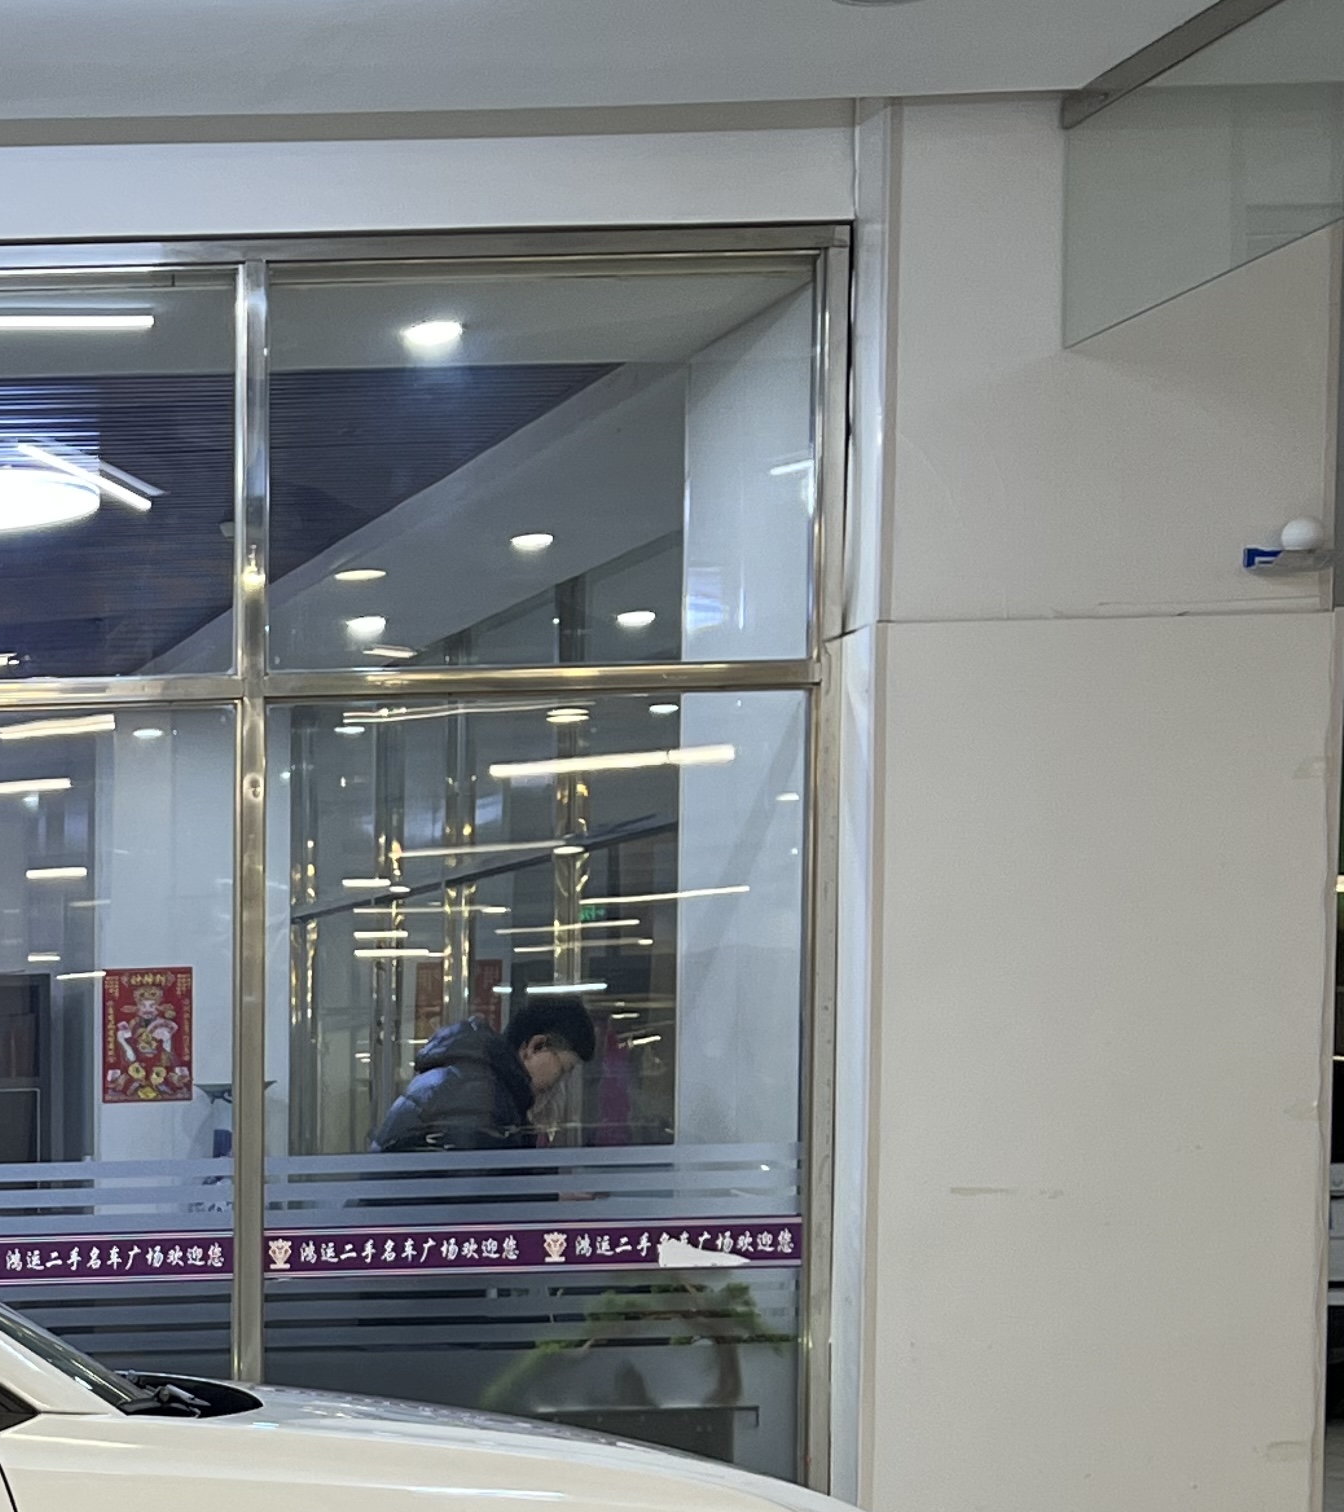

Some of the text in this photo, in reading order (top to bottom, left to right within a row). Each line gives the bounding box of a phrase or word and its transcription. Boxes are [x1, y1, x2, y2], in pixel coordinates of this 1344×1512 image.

[6, 1242, 225, 1272] 鸿运二手名车广场欢迎您
[300, 1234, 520, 1264] 鸿运二手名车广场欢迎您
